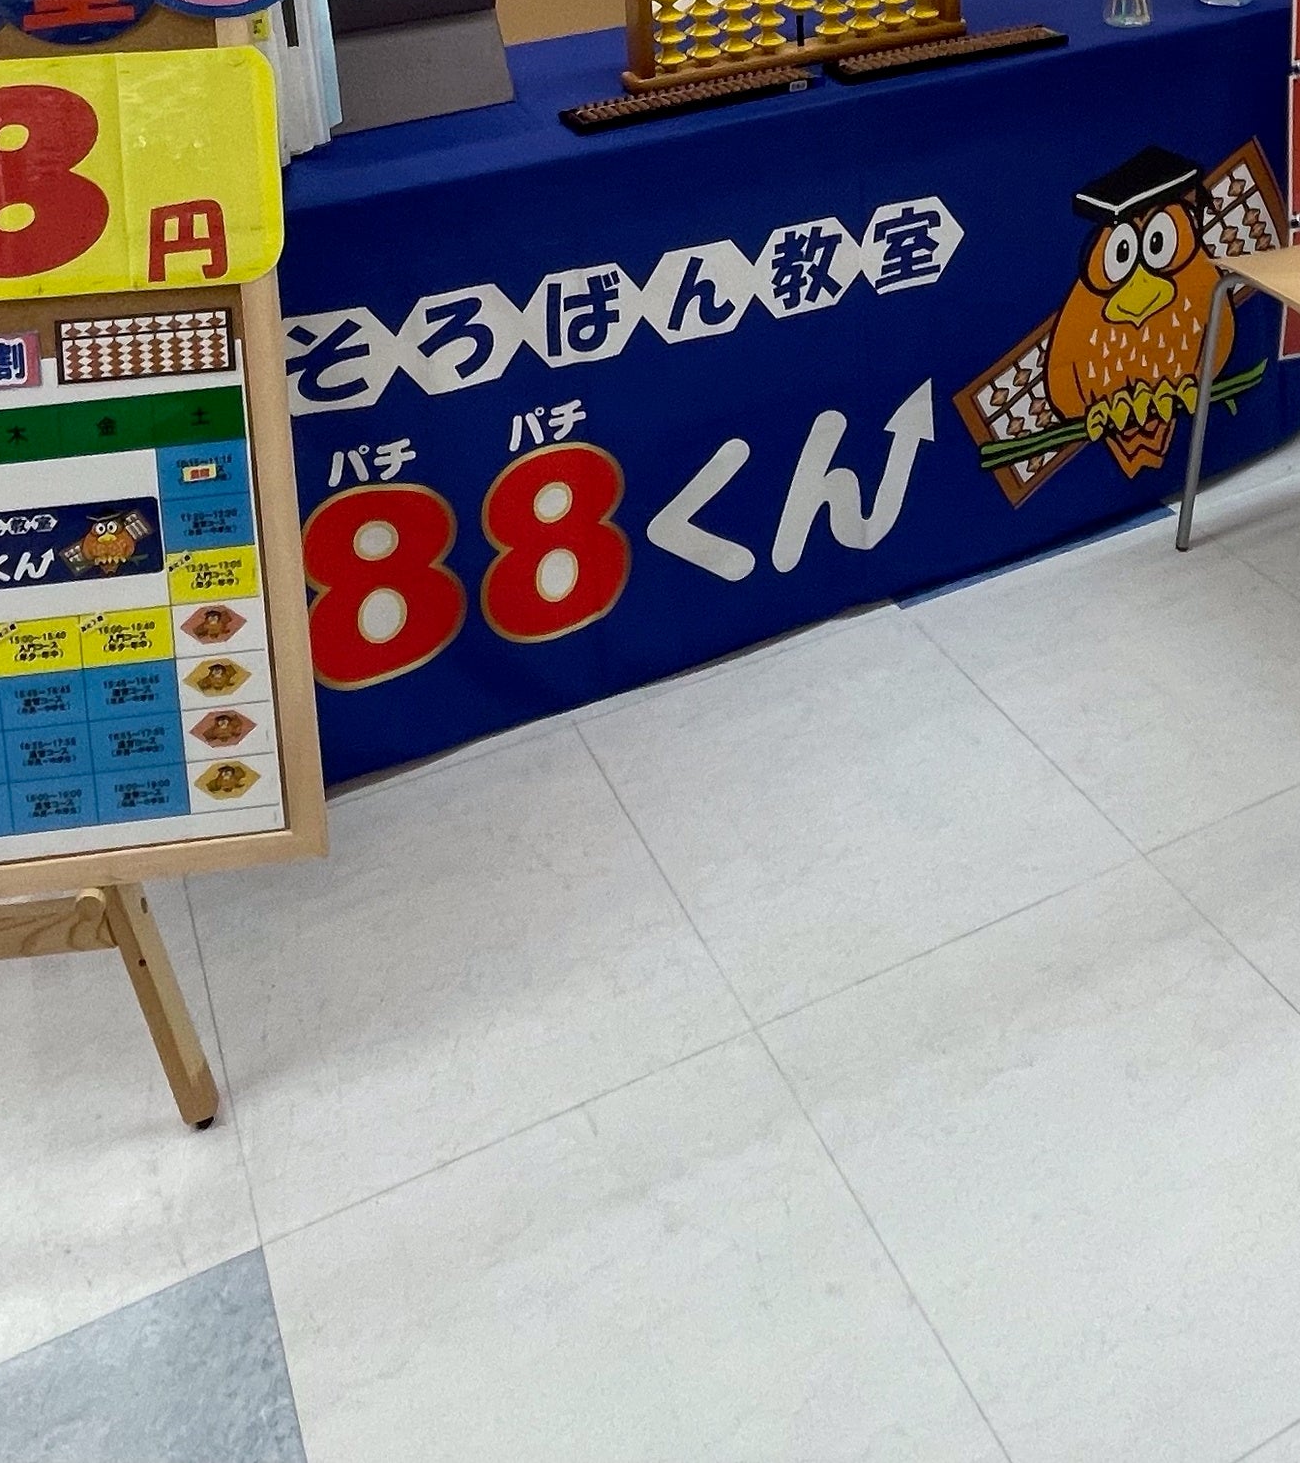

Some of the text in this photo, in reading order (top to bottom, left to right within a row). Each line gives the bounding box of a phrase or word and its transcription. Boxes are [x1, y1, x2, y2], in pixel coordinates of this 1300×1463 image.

[287, 206, 944, 403] そろばん教室
[7, 425, 28, 443] 木
[96, 416, 118, 436] 金
[190, 407, 211, 427] 土
[328, 399, 588, 488] パチ パチ
[302, 379, 935, 691] 88くん
